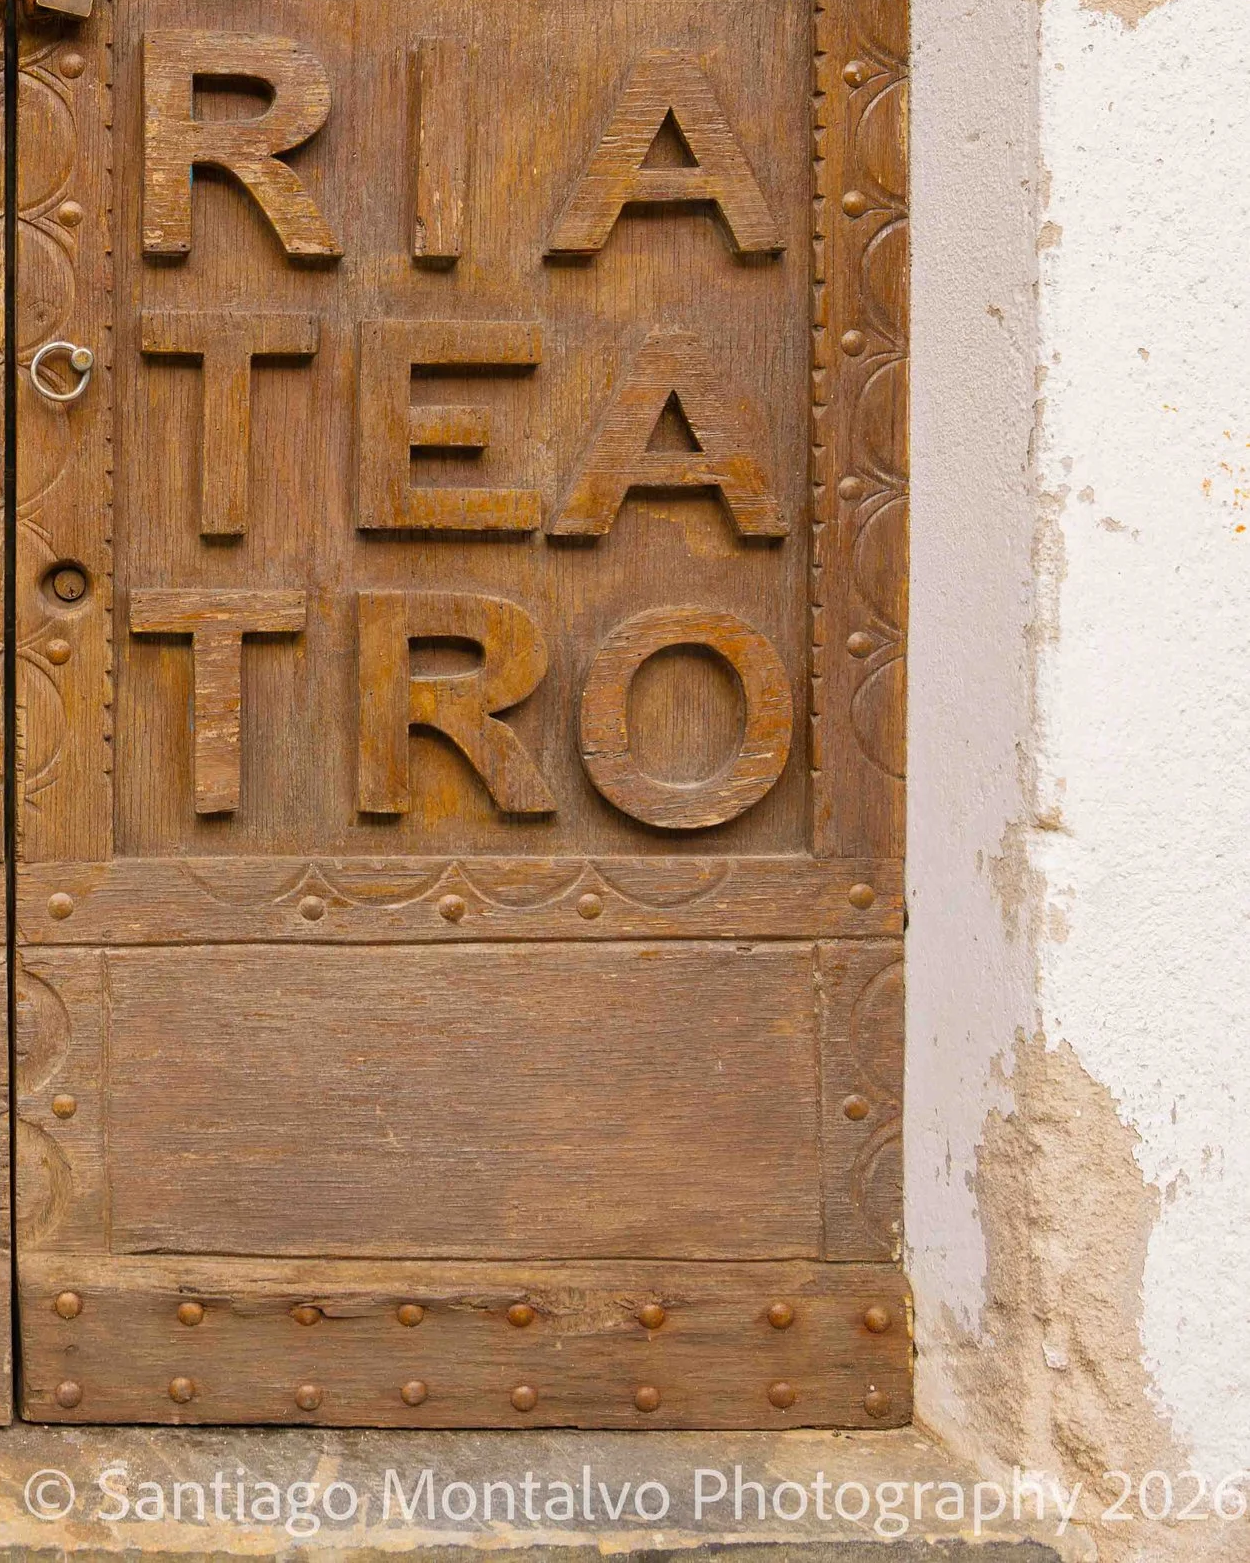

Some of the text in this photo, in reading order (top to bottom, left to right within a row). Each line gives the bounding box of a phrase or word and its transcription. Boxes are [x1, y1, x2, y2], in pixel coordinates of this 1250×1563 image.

[142, 30, 786, 261] RIA
[140, 311, 790, 538] TEA
[129, 589, 794, 829] TRO
